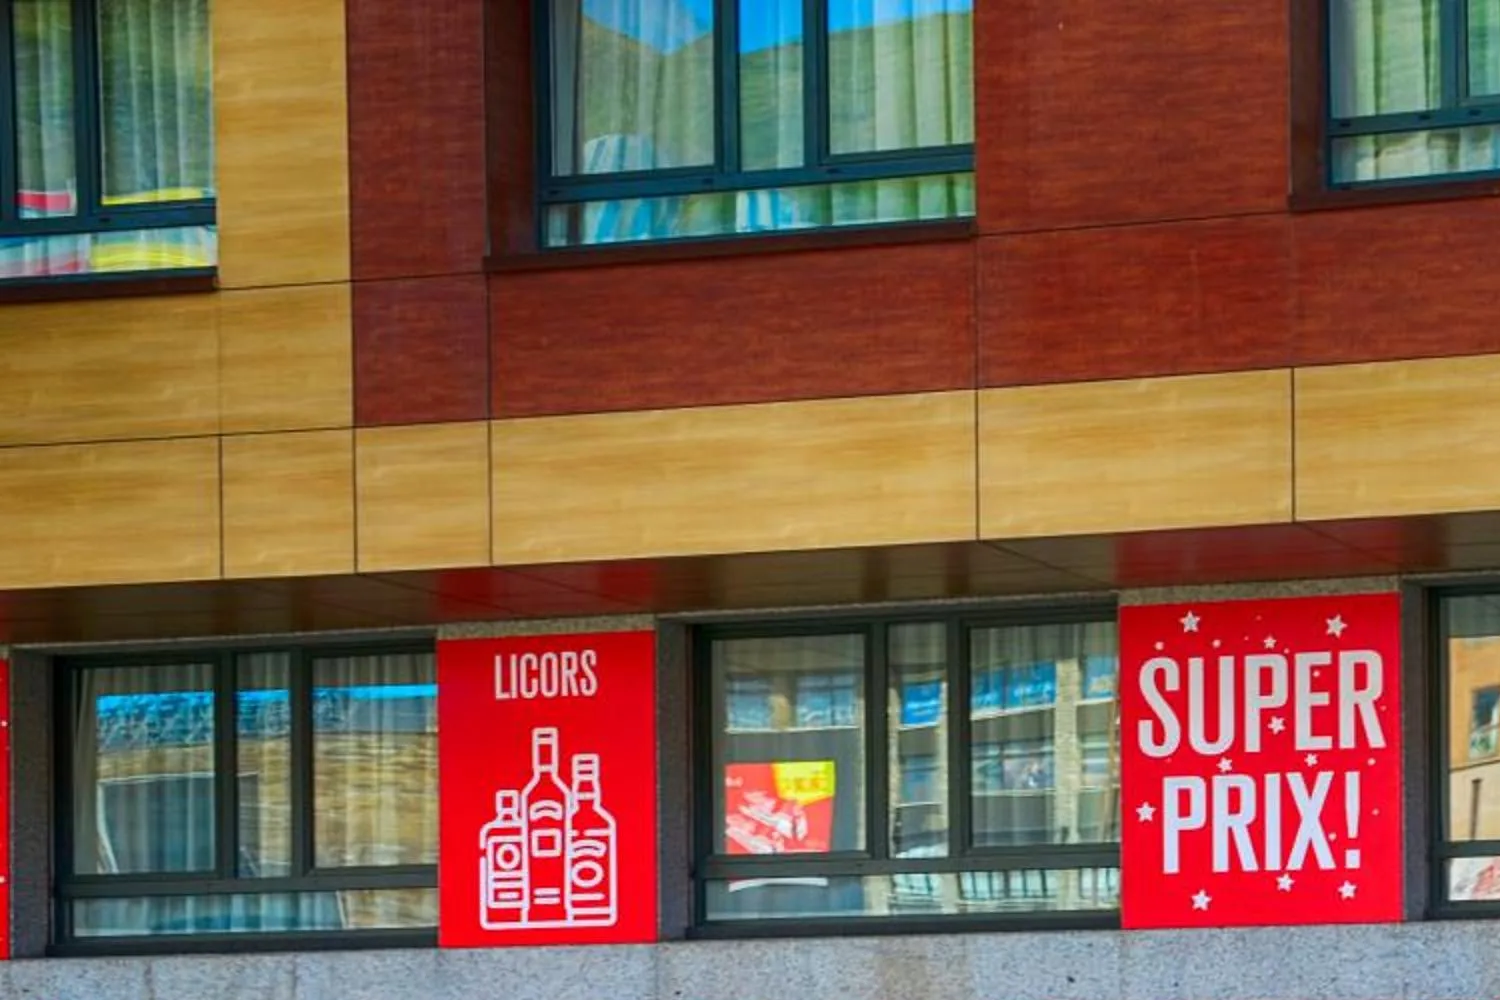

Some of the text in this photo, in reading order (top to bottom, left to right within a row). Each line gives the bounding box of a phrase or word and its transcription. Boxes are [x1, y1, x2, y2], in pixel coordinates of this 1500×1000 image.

[494, 649, 598, 701] LICORS
[1137, 649, 1387, 759] SUPER
[1162, 770, 1361, 875] PRIX!
